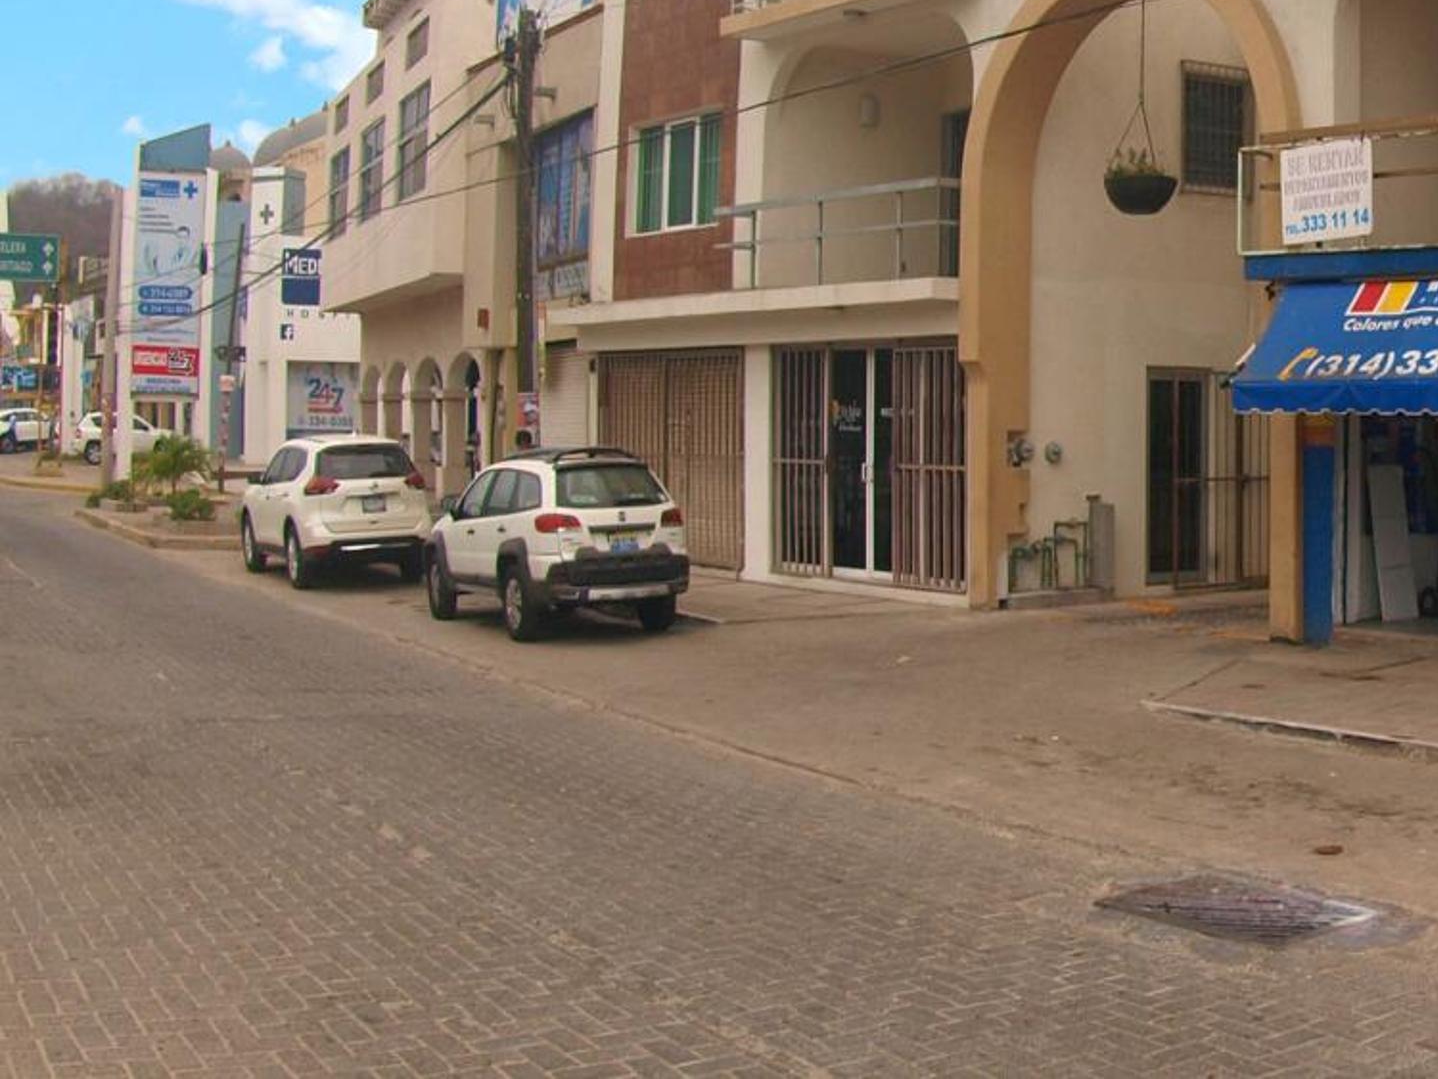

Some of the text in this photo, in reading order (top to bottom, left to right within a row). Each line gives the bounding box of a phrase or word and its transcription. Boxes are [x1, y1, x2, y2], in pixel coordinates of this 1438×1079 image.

[1301, 213, 1327, 232] 333
[1332, 210, 1346, 229] 11
[1353, 207, 1369, 225] 14
[1343, 318, 1398, 332] Colores
[1403, 316, 1432, 330] que
